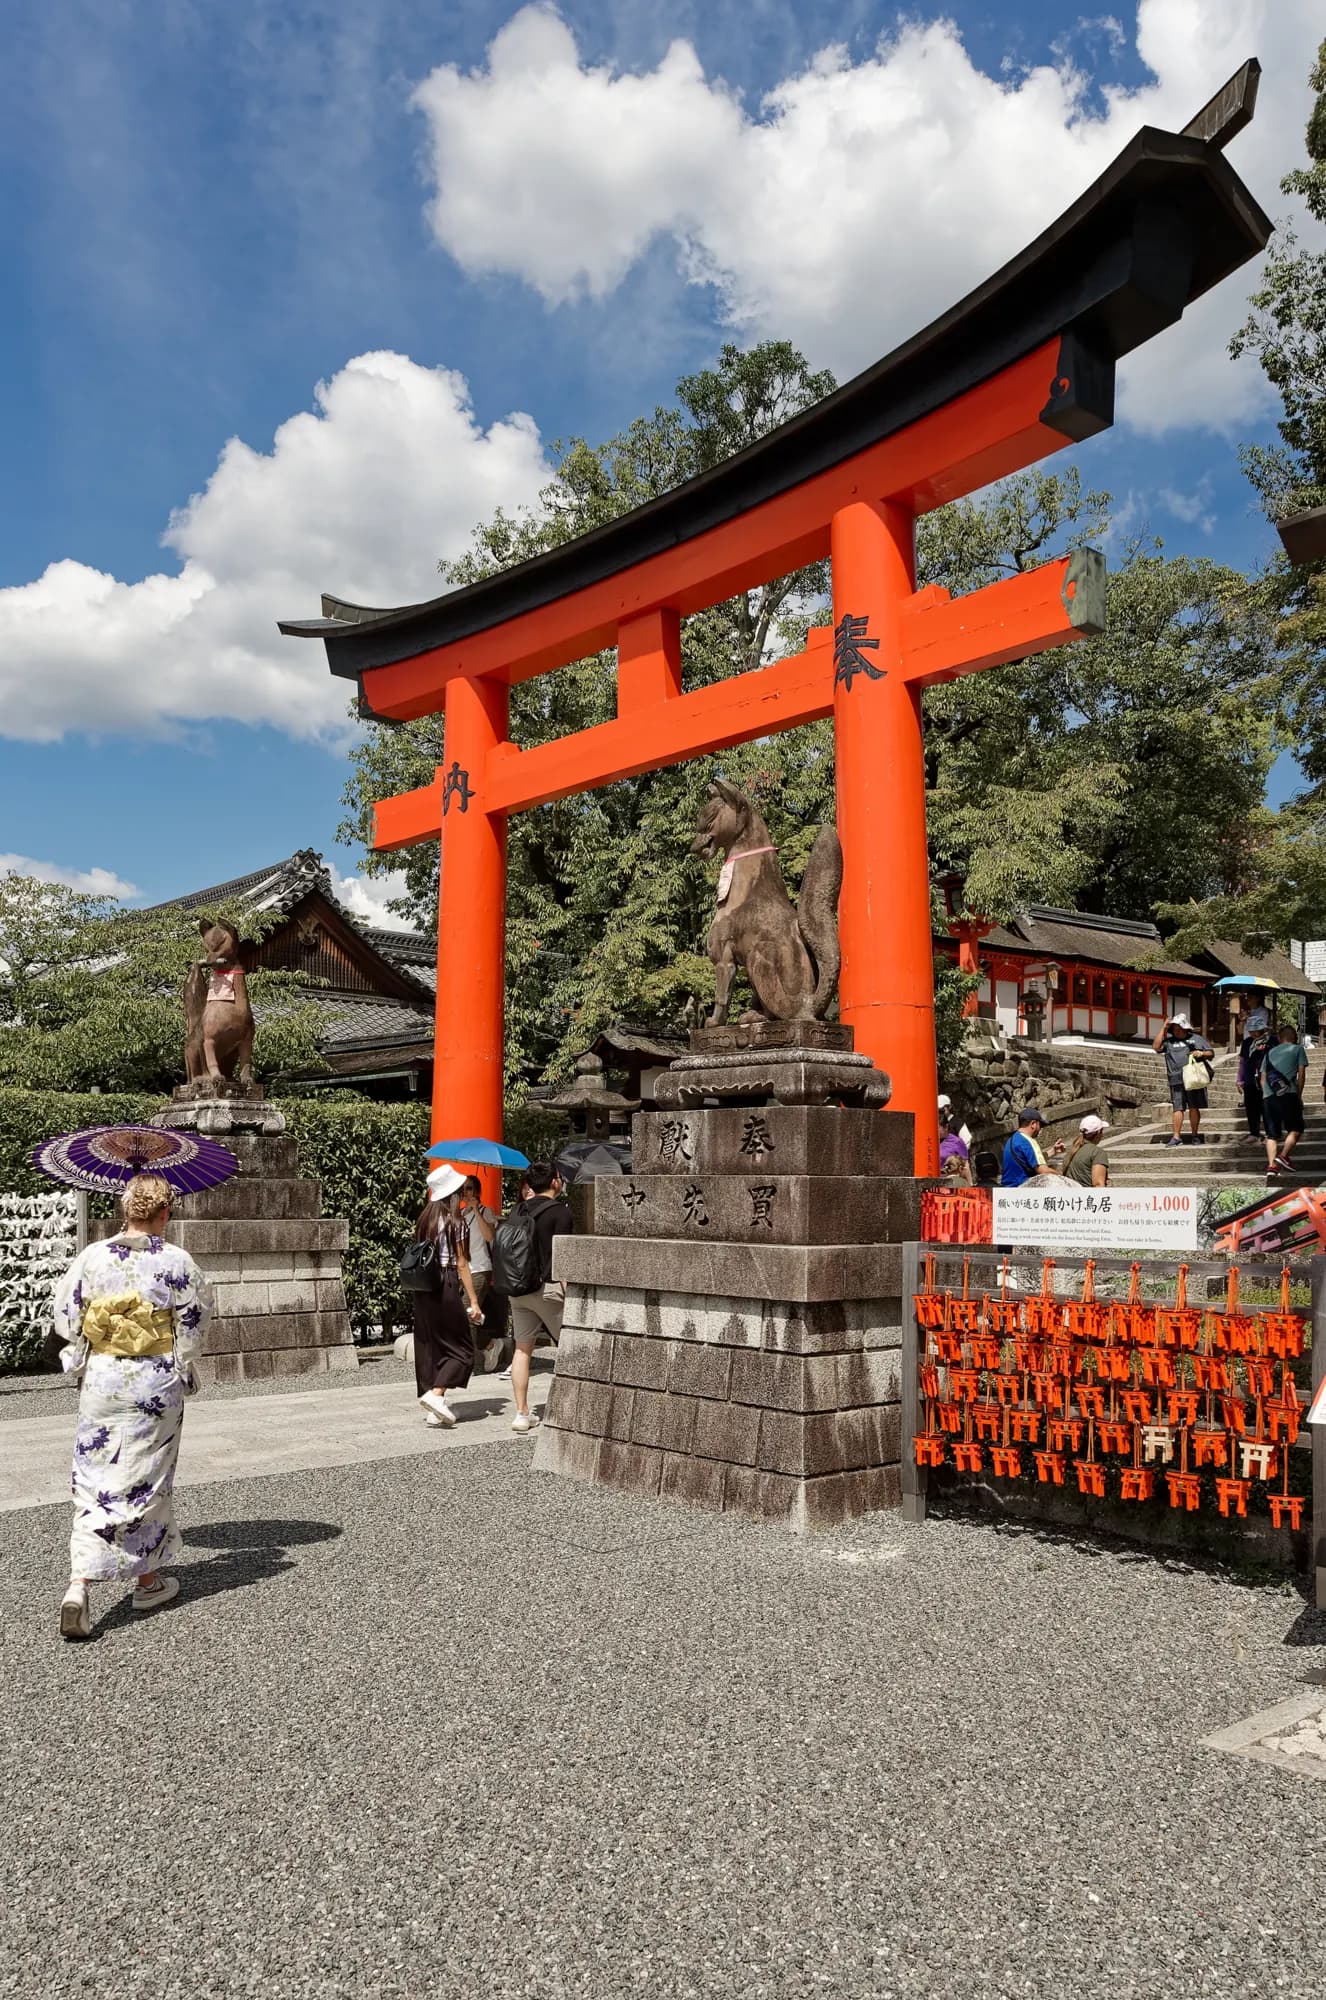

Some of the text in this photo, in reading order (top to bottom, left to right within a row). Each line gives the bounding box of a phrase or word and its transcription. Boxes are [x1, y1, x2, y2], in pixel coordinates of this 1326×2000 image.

[833, 613, 888, 696] 奉
[997, 1195, 1112, 1213] 願いが通る 願かけ鳥居
